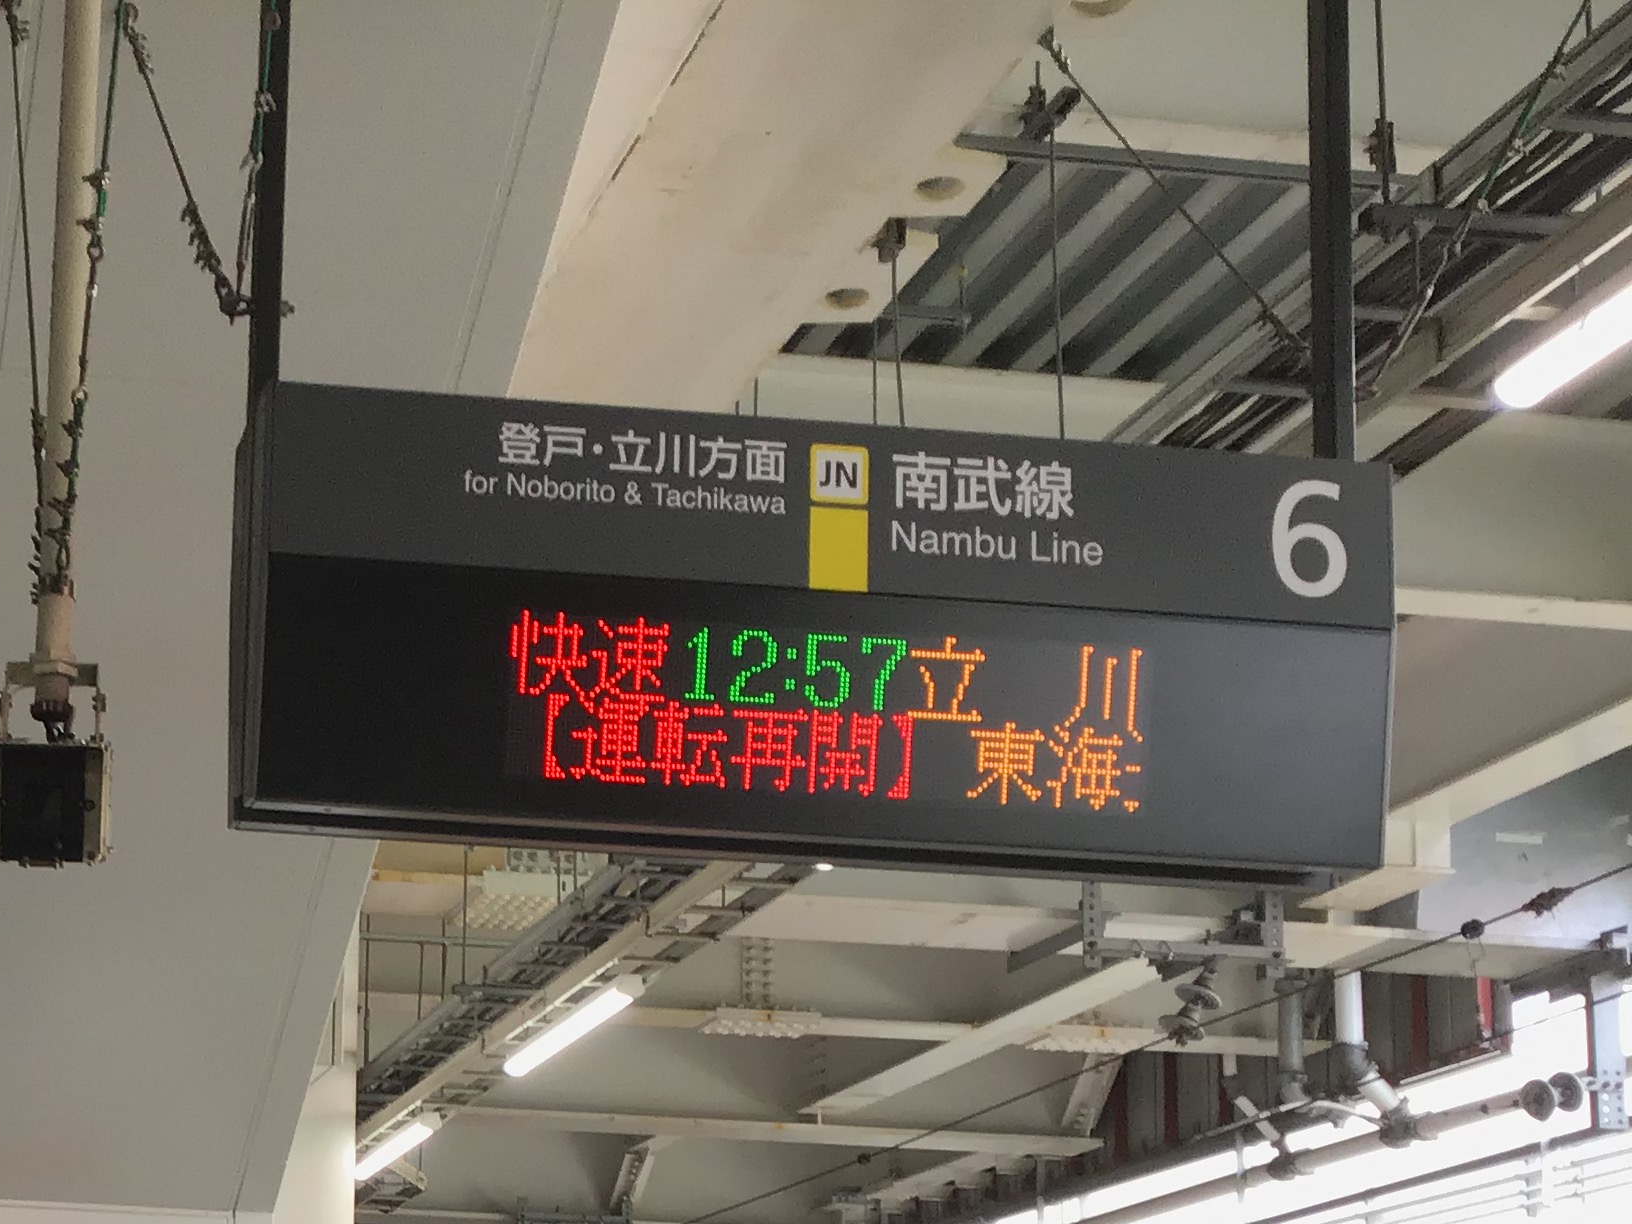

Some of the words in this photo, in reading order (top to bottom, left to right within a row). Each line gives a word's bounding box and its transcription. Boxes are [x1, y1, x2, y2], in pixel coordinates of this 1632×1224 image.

[497, 421, 787, 484] 登戸・立川方面
[817, 461, 859, 490] JN
[464, 469, 495, 495] for
[507, 472, 616, 505] Noborito
[624, 482, 643, 505] &
[651, 482, 787, 516] Tachikawa
[892, 451, 1076, 522] 南武線
[891, 519, 1018, 562] Nambu
[1031, 530, 1105, 567] Line
[1271, 479, 1349, 598] 6
[509, 609, 671, 706] 快速
[684, 627, 909, 711] 12:57
